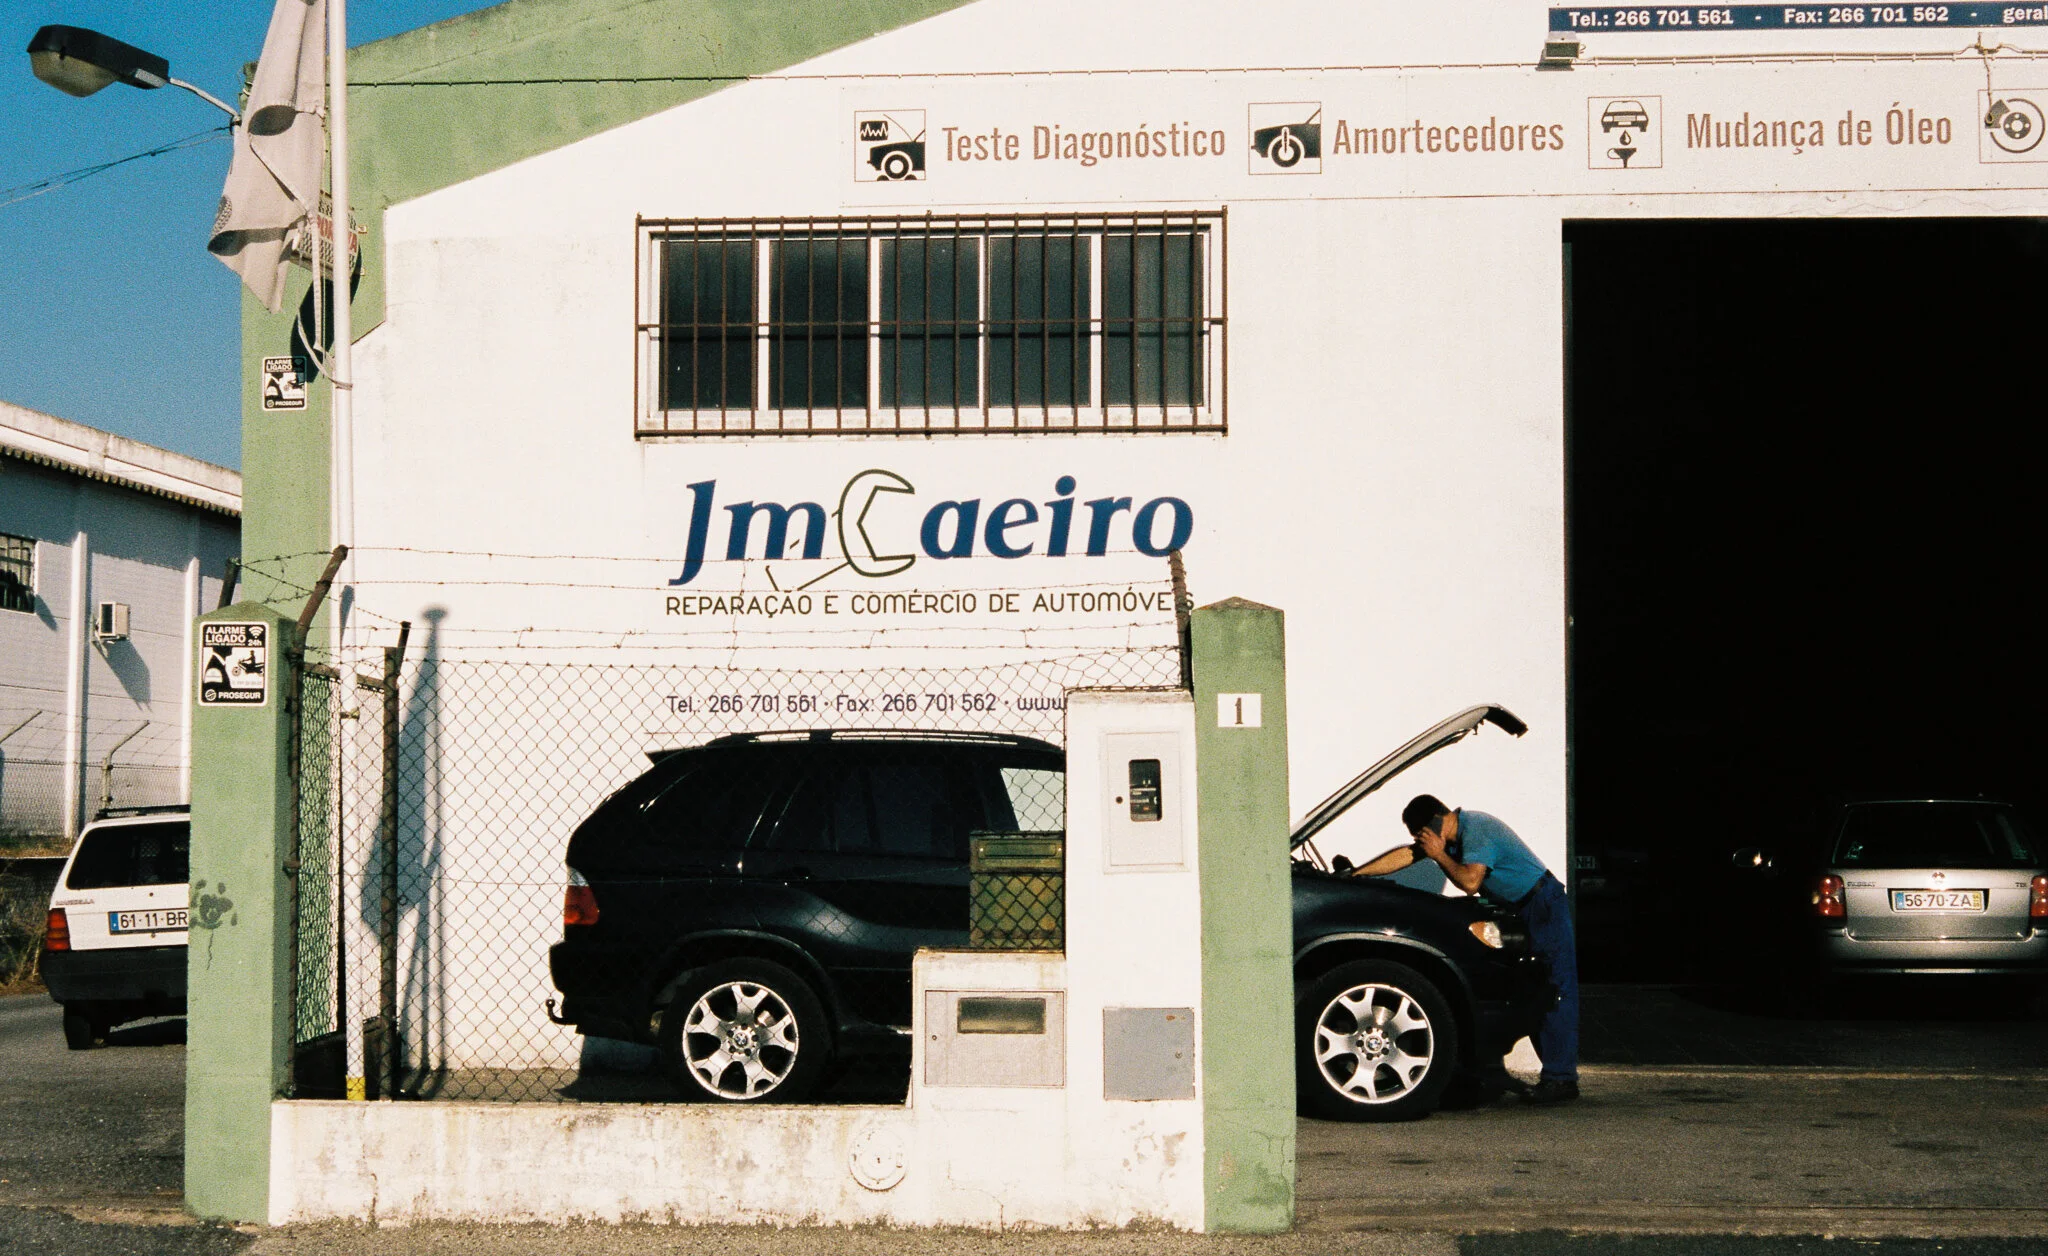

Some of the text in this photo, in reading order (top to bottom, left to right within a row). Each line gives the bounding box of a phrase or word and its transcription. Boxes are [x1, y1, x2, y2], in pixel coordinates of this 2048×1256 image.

[1569, 11, 1609, 26] Tel.:
[1614, 10, 1650, 25] 266
[1656, 10, 1692, 25] 701
[1698, 9, 1733, 24] 561
[1784, 8, 1822, 24] Fax:
[1829, 8, 1864, 23] 266
[1871, 8, 1906, 22] 701
[1912, 7, 1948, 22] 562
[1333, 116, 1564, 154] Amortecedores
[1687, 102, 1952, 155] Mudança de Óleo
[942, 122, 1226, 166] Teste Diagonóstico
[667, 586, 1195, 617] REPARAÇÃO E COMÉRCIO DE AUTOMÓVES
[218, 691, 261, 699] PROSEGUR
[709, 695, 743, 713] 266
[749, 695, 781, 713] 701
[786, 695, 818, 713] 561
[835, 694, 875, 713] Fax:
[882, 694, 918, 712] 266
[924, 694, 955, 712] 701
[961, 694, 997, 712] 562
[1234, 697, 1243, 725] 1
